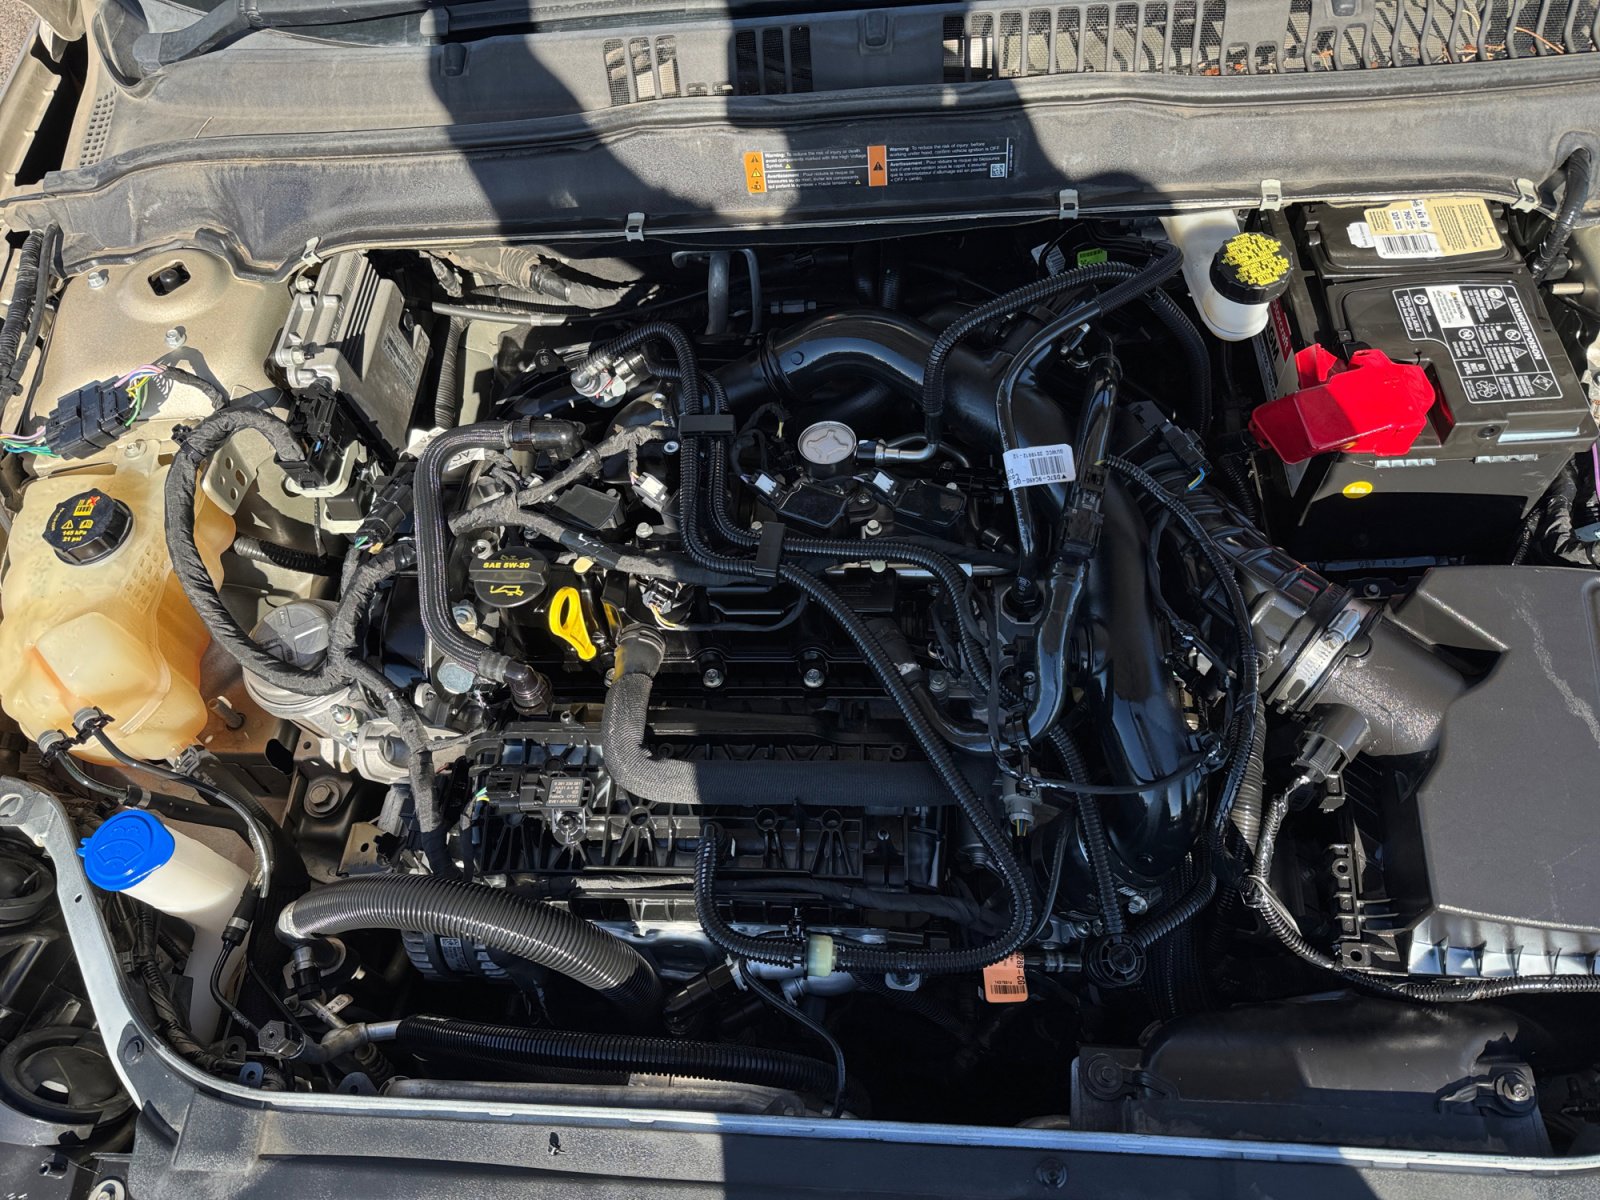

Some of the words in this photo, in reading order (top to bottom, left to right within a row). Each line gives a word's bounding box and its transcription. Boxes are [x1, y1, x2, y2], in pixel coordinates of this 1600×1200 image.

[1397, 297, 1406, 307] Lead
[1400, 295, 1423, 332] NON-SPILLABLE
[1401, 307, 1409, 316] Acid
[1403, 316, 1415, 330] Battery
[1511, 302, 1542, 360] DANGER/POISON
